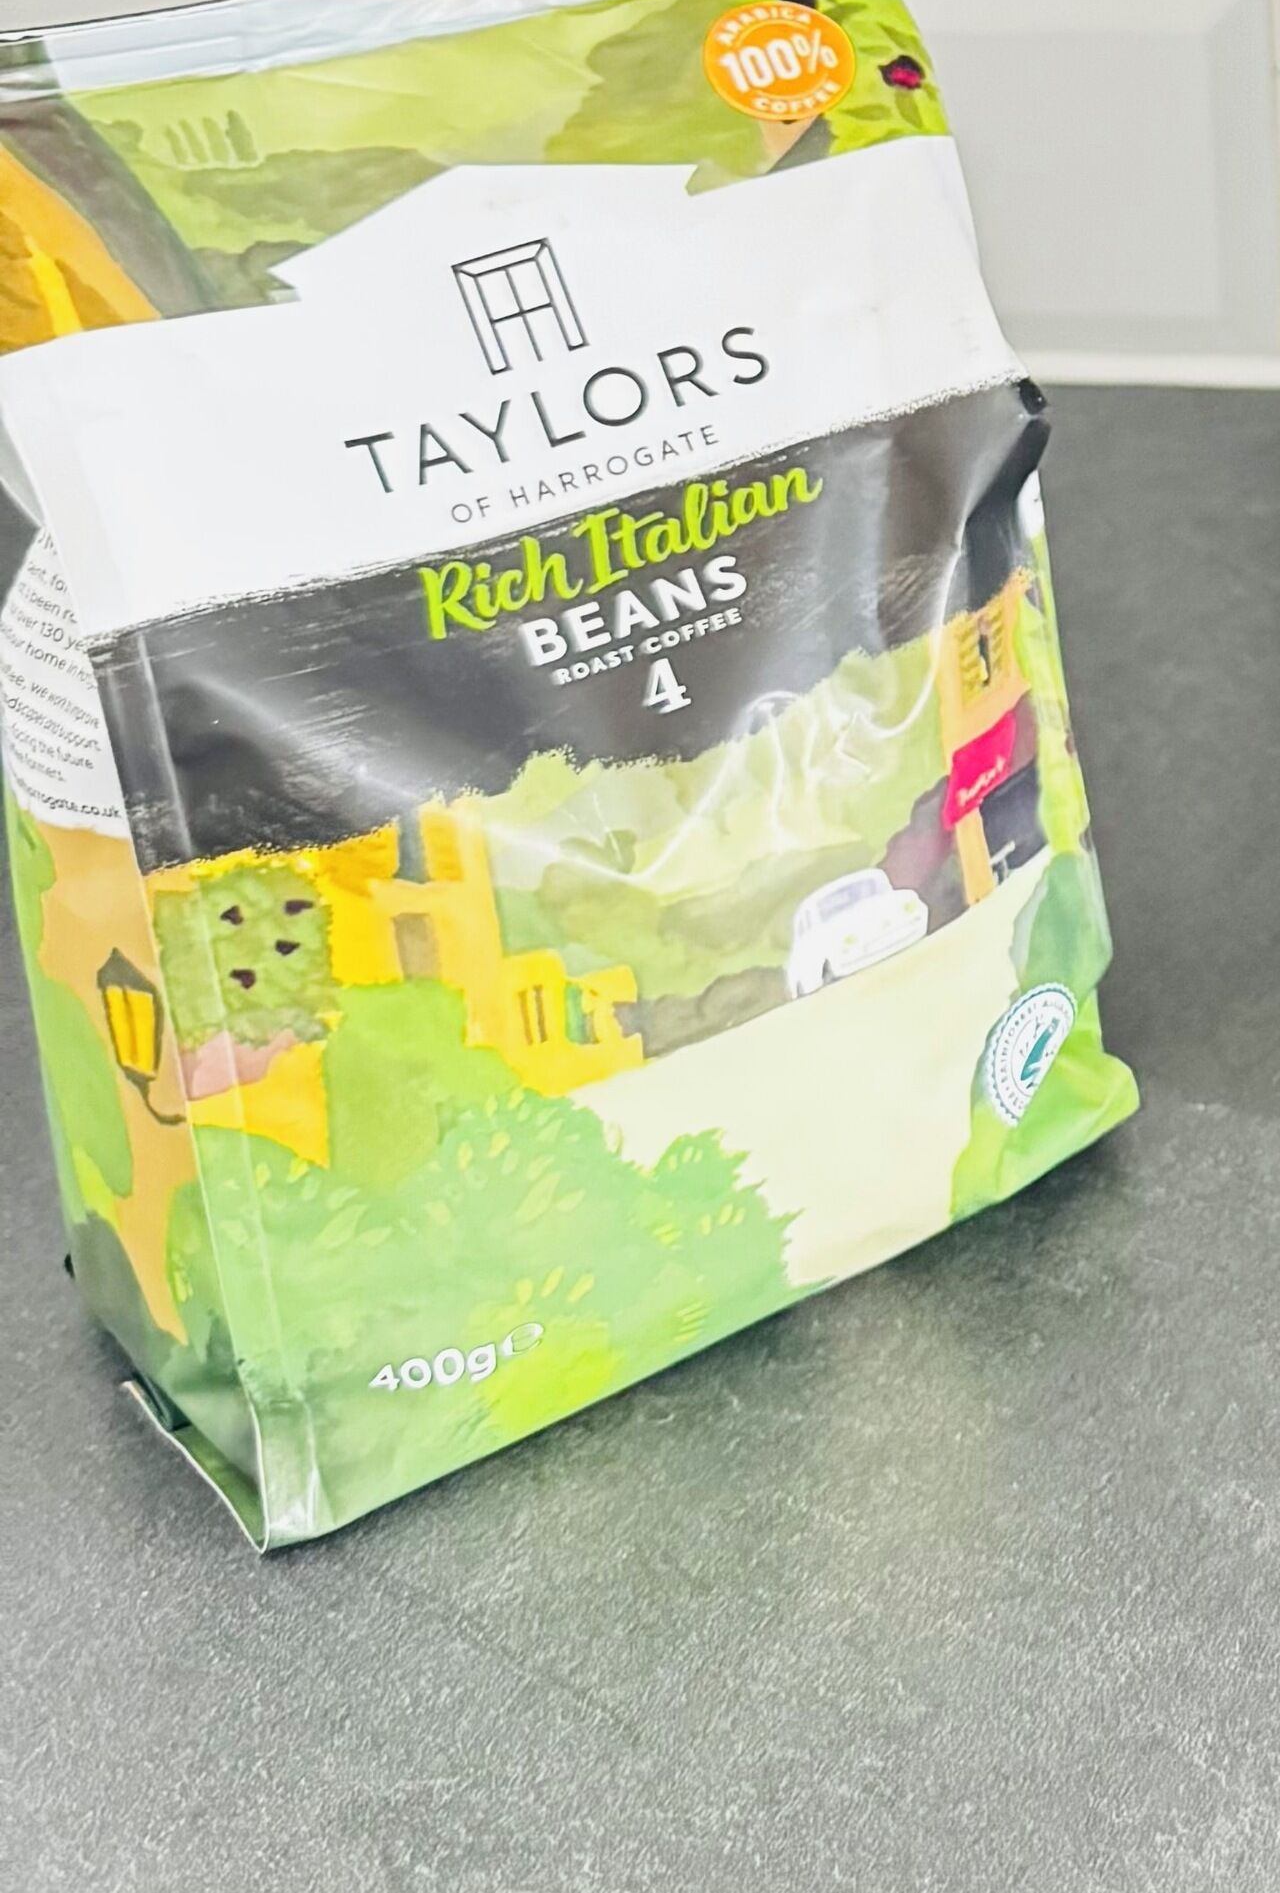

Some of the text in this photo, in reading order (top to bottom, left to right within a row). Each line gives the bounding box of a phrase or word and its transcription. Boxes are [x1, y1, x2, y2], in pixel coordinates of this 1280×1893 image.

[716, 8, 811, 46] ARABICA
[719, 29, 839, 93] 100%
[751, 80, 841, 114] COFFEE
[344, 326, 770, 494] TAYLORS
[450, 424, 721, 524] OF HARROGATE
[417, 467, 824, 641] Rich Italian
[40, 621, 65, 643] 130
[518, 554, 748, 667] BEANS
[25, 641, 67, 670] home
[551, 607, 744, 686] ROAST COFFEE
[642, 657, 693, 715] 4
[368, 1342, 497, 1392] 400g
